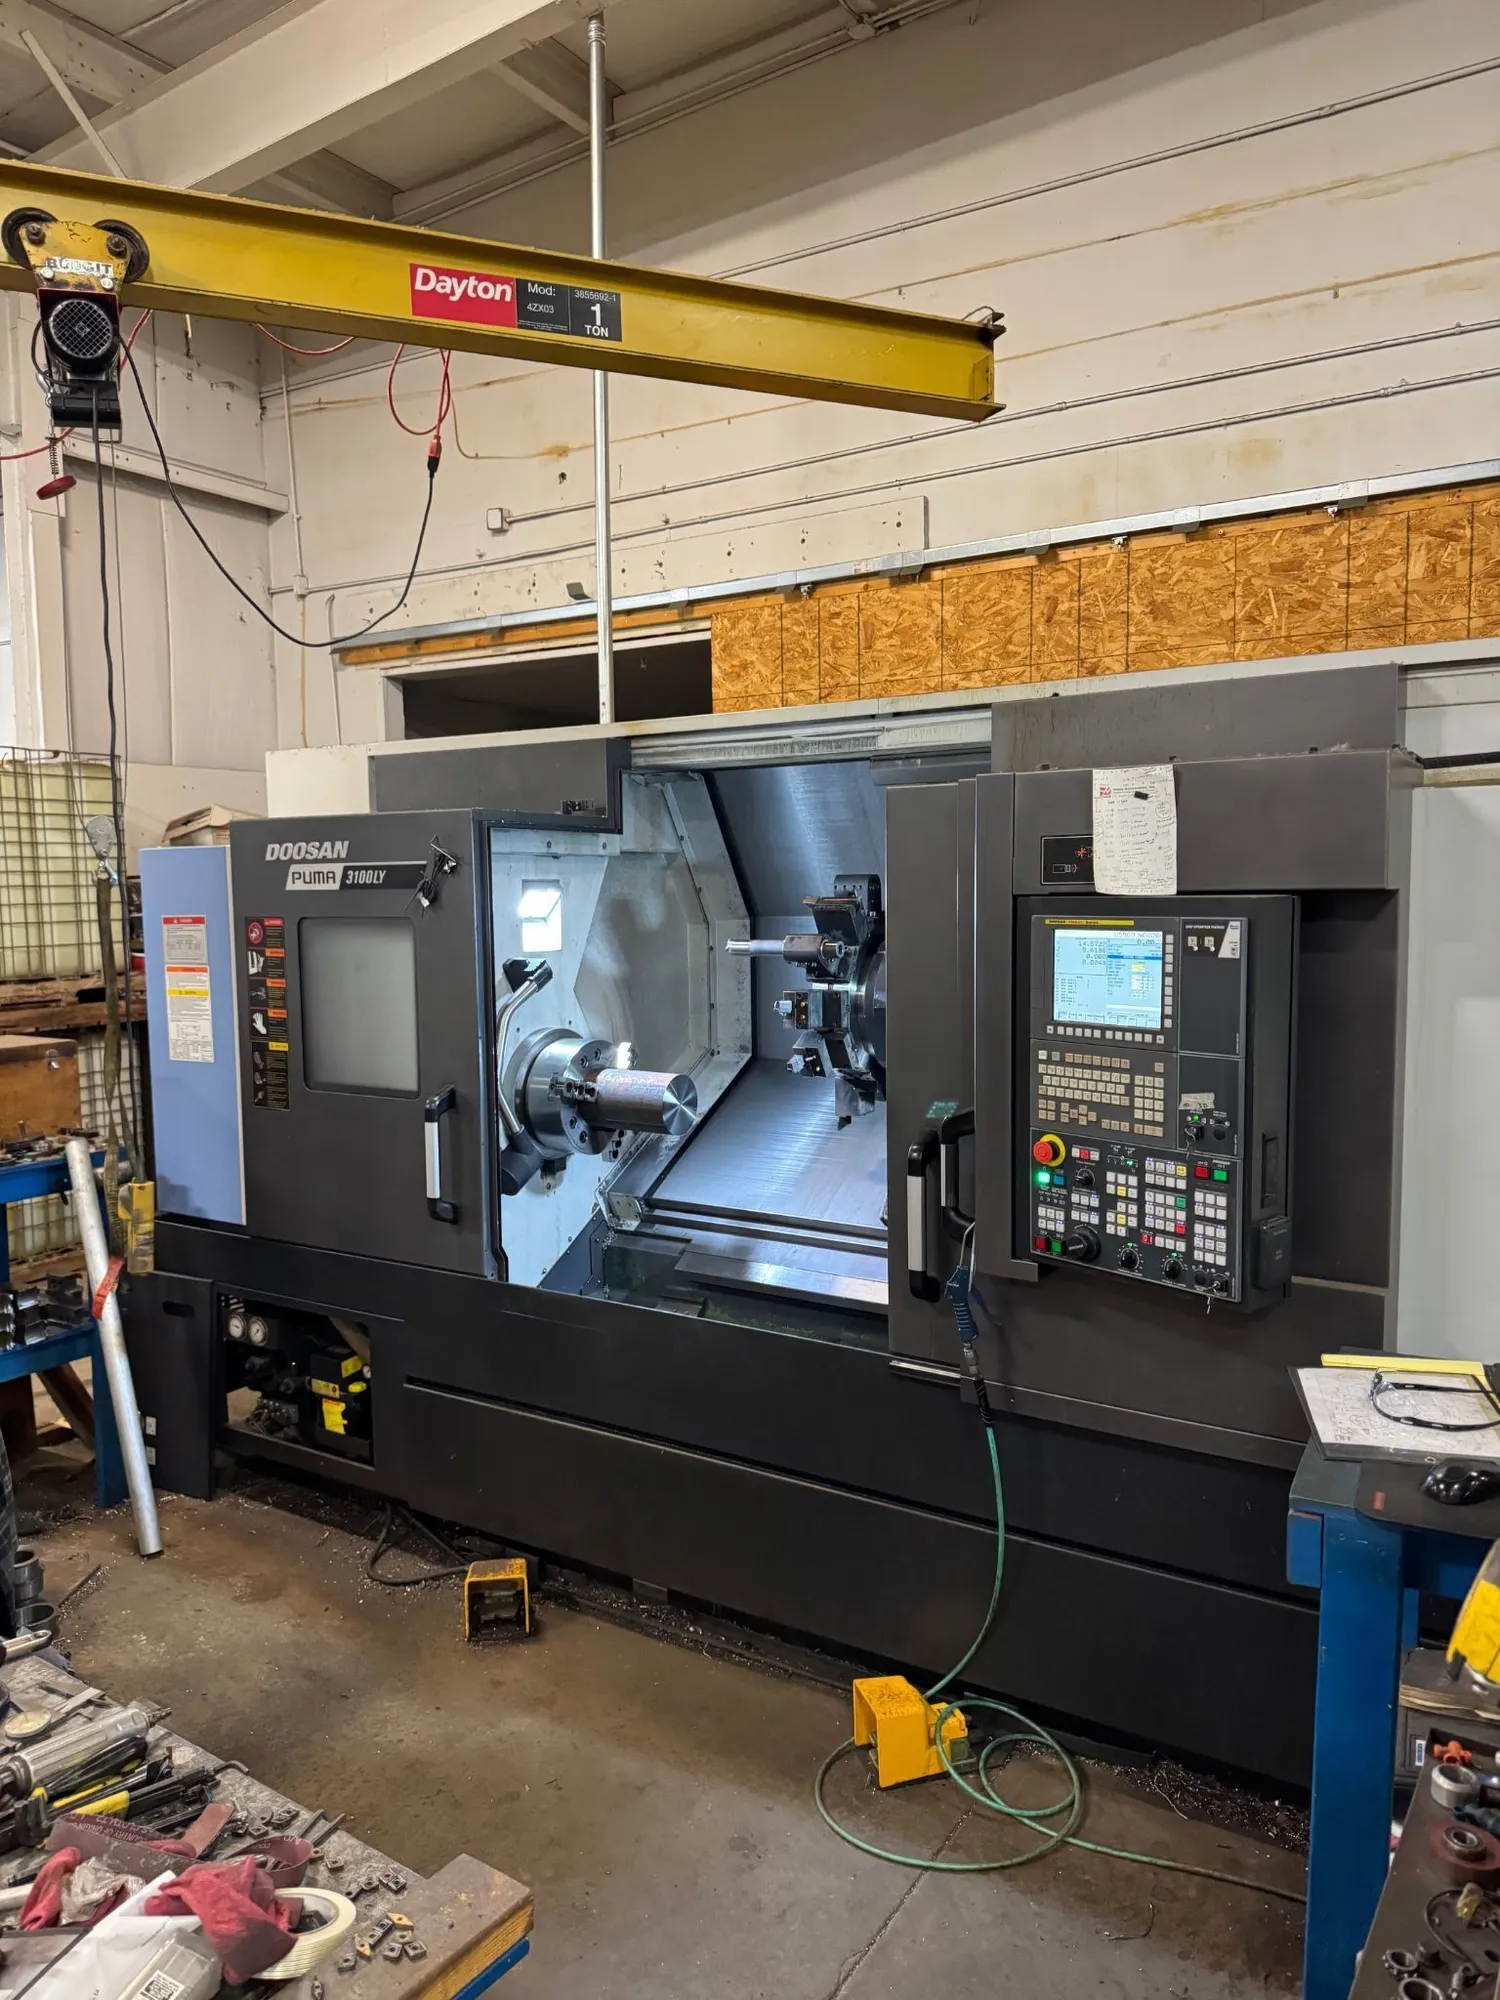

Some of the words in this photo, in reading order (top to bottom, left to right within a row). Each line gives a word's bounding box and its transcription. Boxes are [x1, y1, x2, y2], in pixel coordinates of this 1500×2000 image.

[414, 268, 512, 302] Dayton
[527, 282, 556, 297] Mod:
[526, 302, 555, 315] 4ZX03
[590, 303, 602, 327] 1
[584, 325, 609, 338] TON
[265, 840, 349, 861] DOOSAN
[291, 870, 336, 885] PUMA
[345, 869, 387, 885] 3100LY
